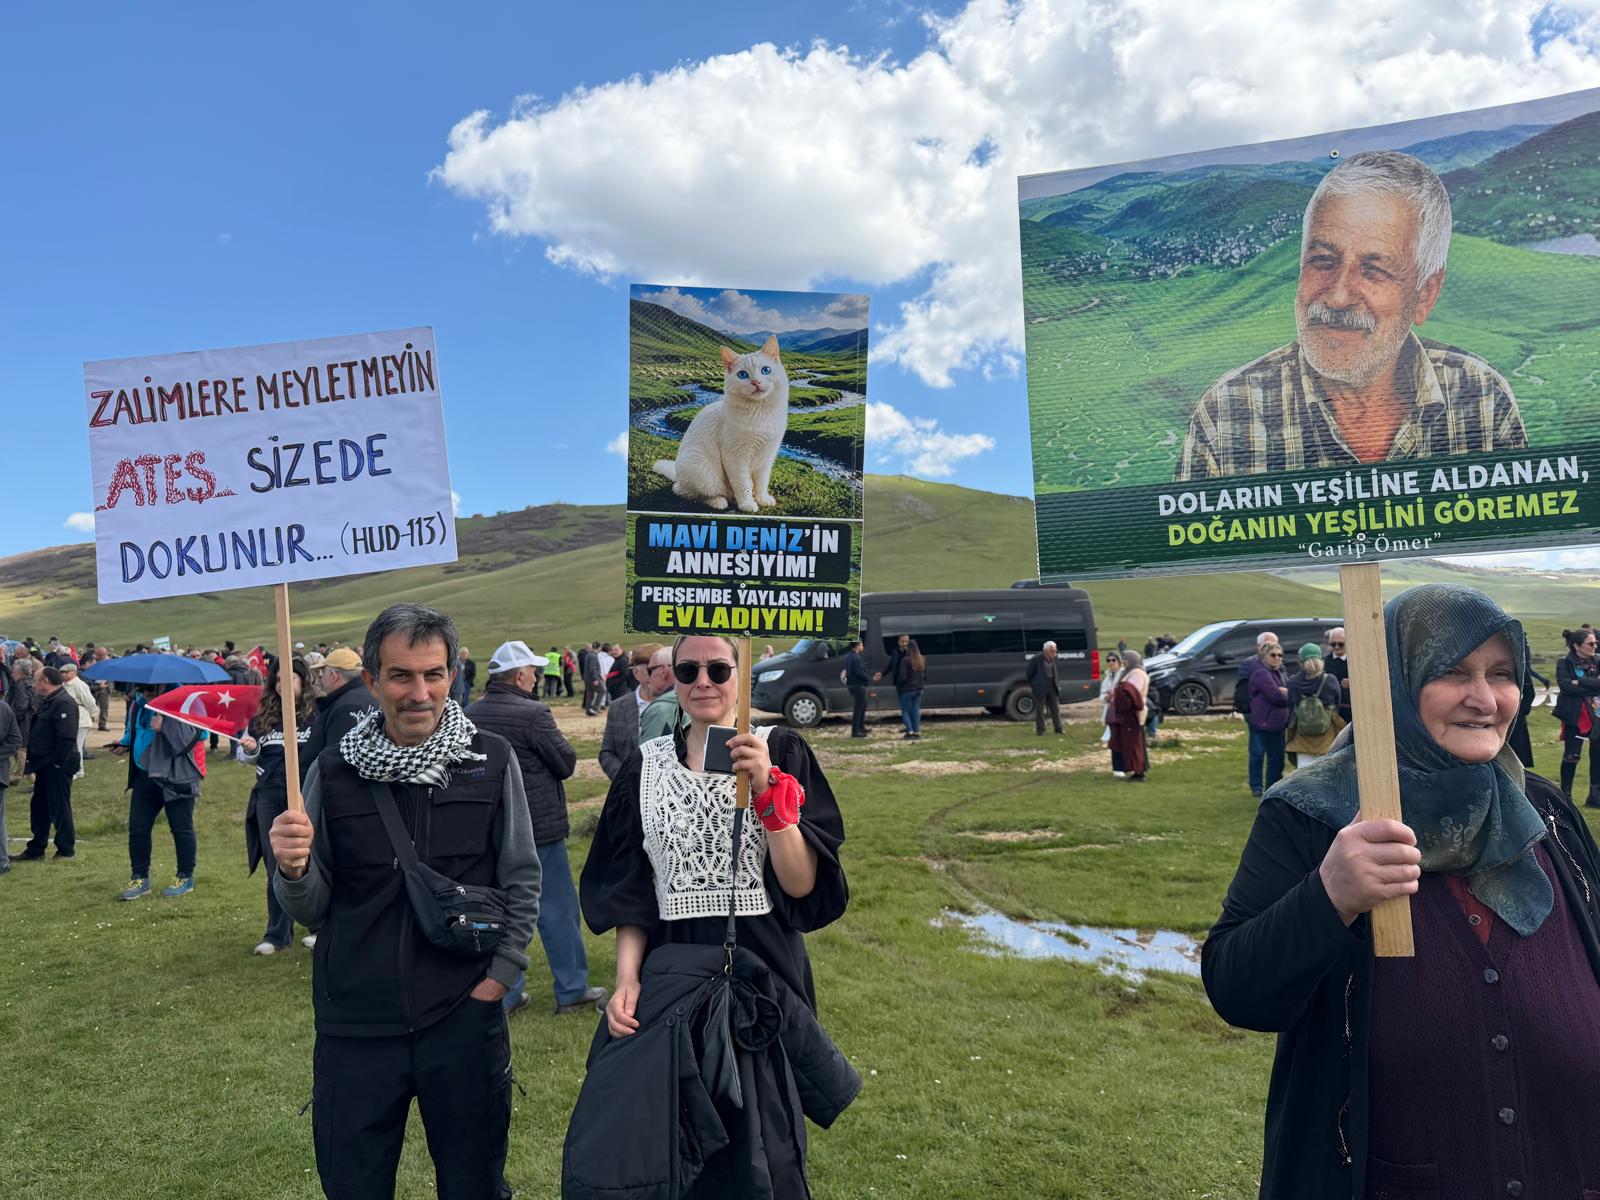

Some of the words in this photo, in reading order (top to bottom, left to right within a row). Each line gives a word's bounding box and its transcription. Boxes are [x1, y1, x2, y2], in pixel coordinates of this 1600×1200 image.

[89, 376, 249, 428] ZALİMLERE
[256, 342, 436, 411] MEYLETMEYİN
[106, 449, 217, 509] ATEŞ
[247, 433, 392, 493] SİZEDE
[1158, 484, 1282, 517] DOLARIN
[1291, 468, 1420, 509] YEŞİLİNE
[1430, 455, 1590, 493] ALDANAN,
[649, 521, 718, 549] MAVİ
[1168, 515, 1297, 546] DOĞANIN
[1305, 497, 1426, 537] YEŞİLİNİ
[1434, 490, 1580, 525] GÖREMEZ
[120, 523, 334, 583] DOKUNUR...
[340, 511, 447, 555] (HUD-113)
[666, 549, 817, 578] ANNESİYİM!
[641, 586, 732, 607] PERŞEMBE
[658, 605, 824, 632] EVLADIYIM!
